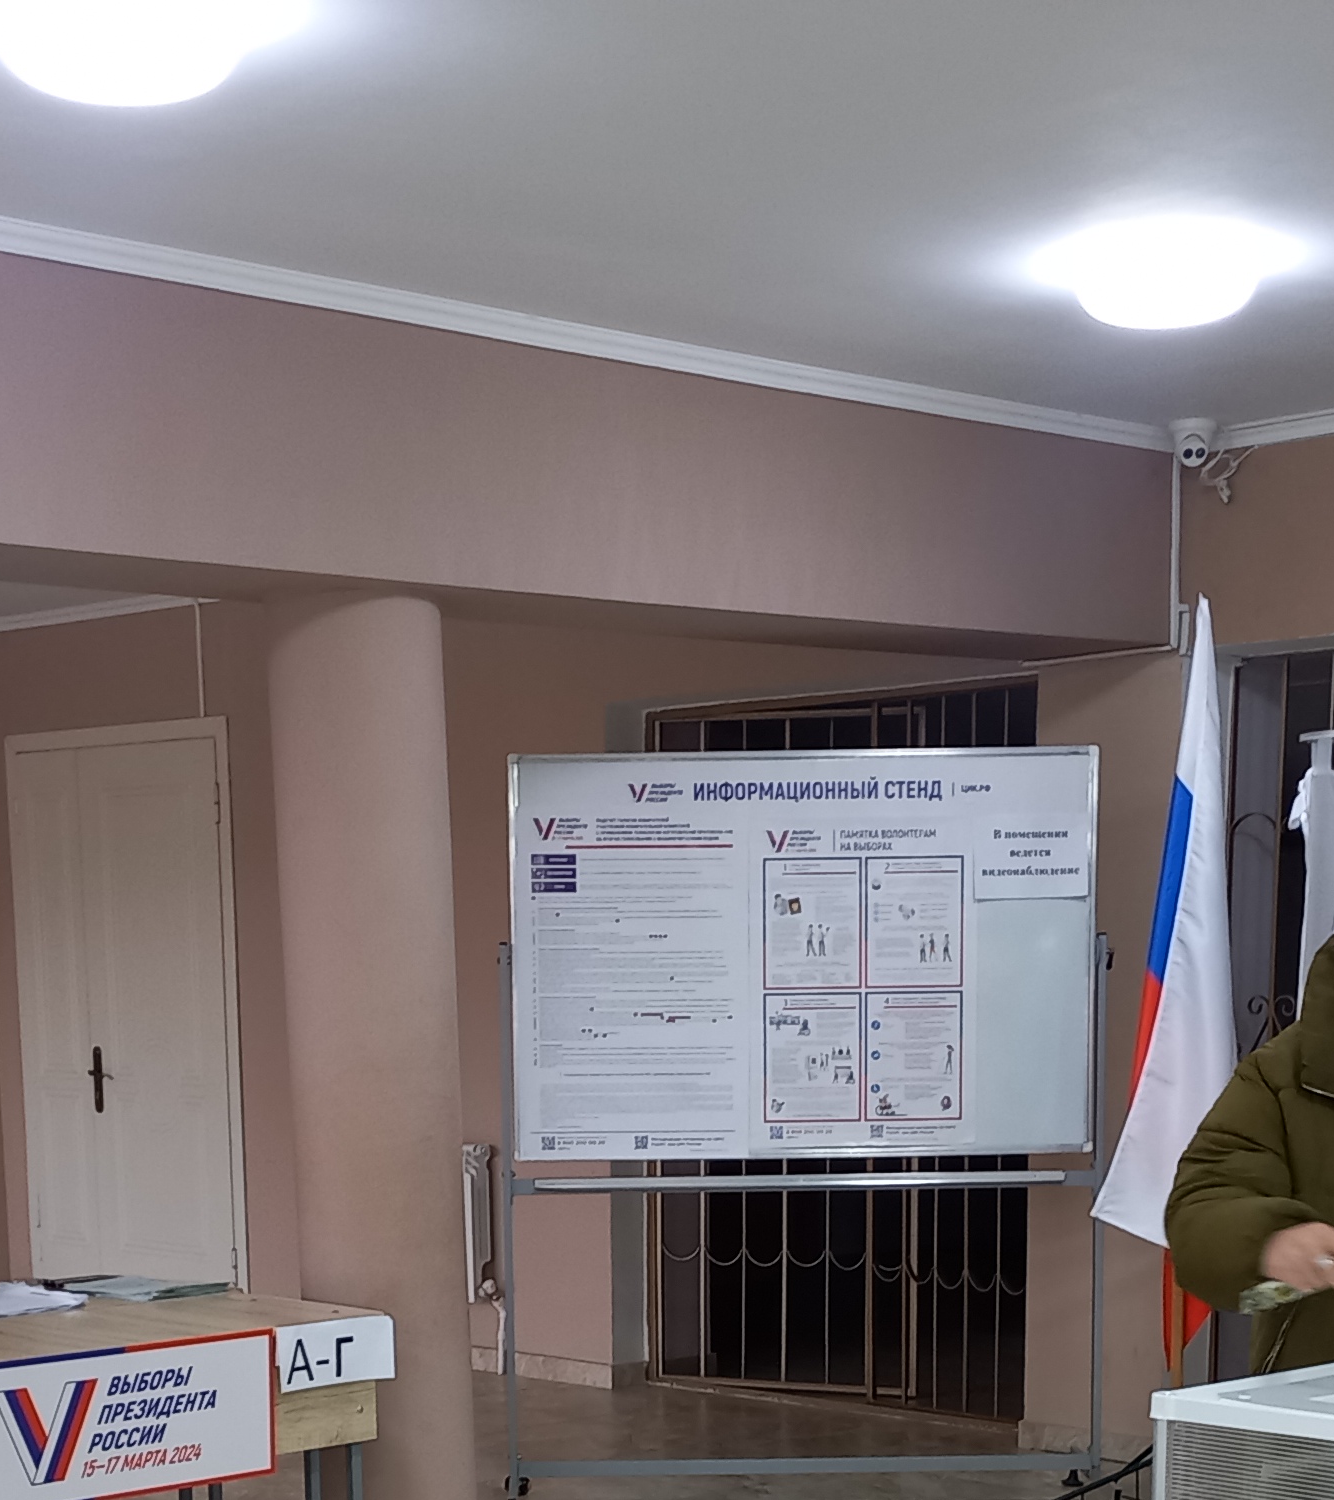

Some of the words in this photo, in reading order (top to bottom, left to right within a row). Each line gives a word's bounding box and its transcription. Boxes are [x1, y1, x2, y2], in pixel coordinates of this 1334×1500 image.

[693, 776, 879, 802] ИНФОРМАЦИОННЫЙ
[884, 780, 942, 801] СТЕНД
[287, 1336, 354, 1385] А-Г
[107, 1366, 193, 1396] ВЫБОРЫ
[97, 1389, 217, 1425] ПРЕЗИДЕНТА
[87, 1423, 167, 1454] РОССИИ
[120, 1448, 167, 1472] МАРТА
[169, 1443, 202, 1464] 2024
